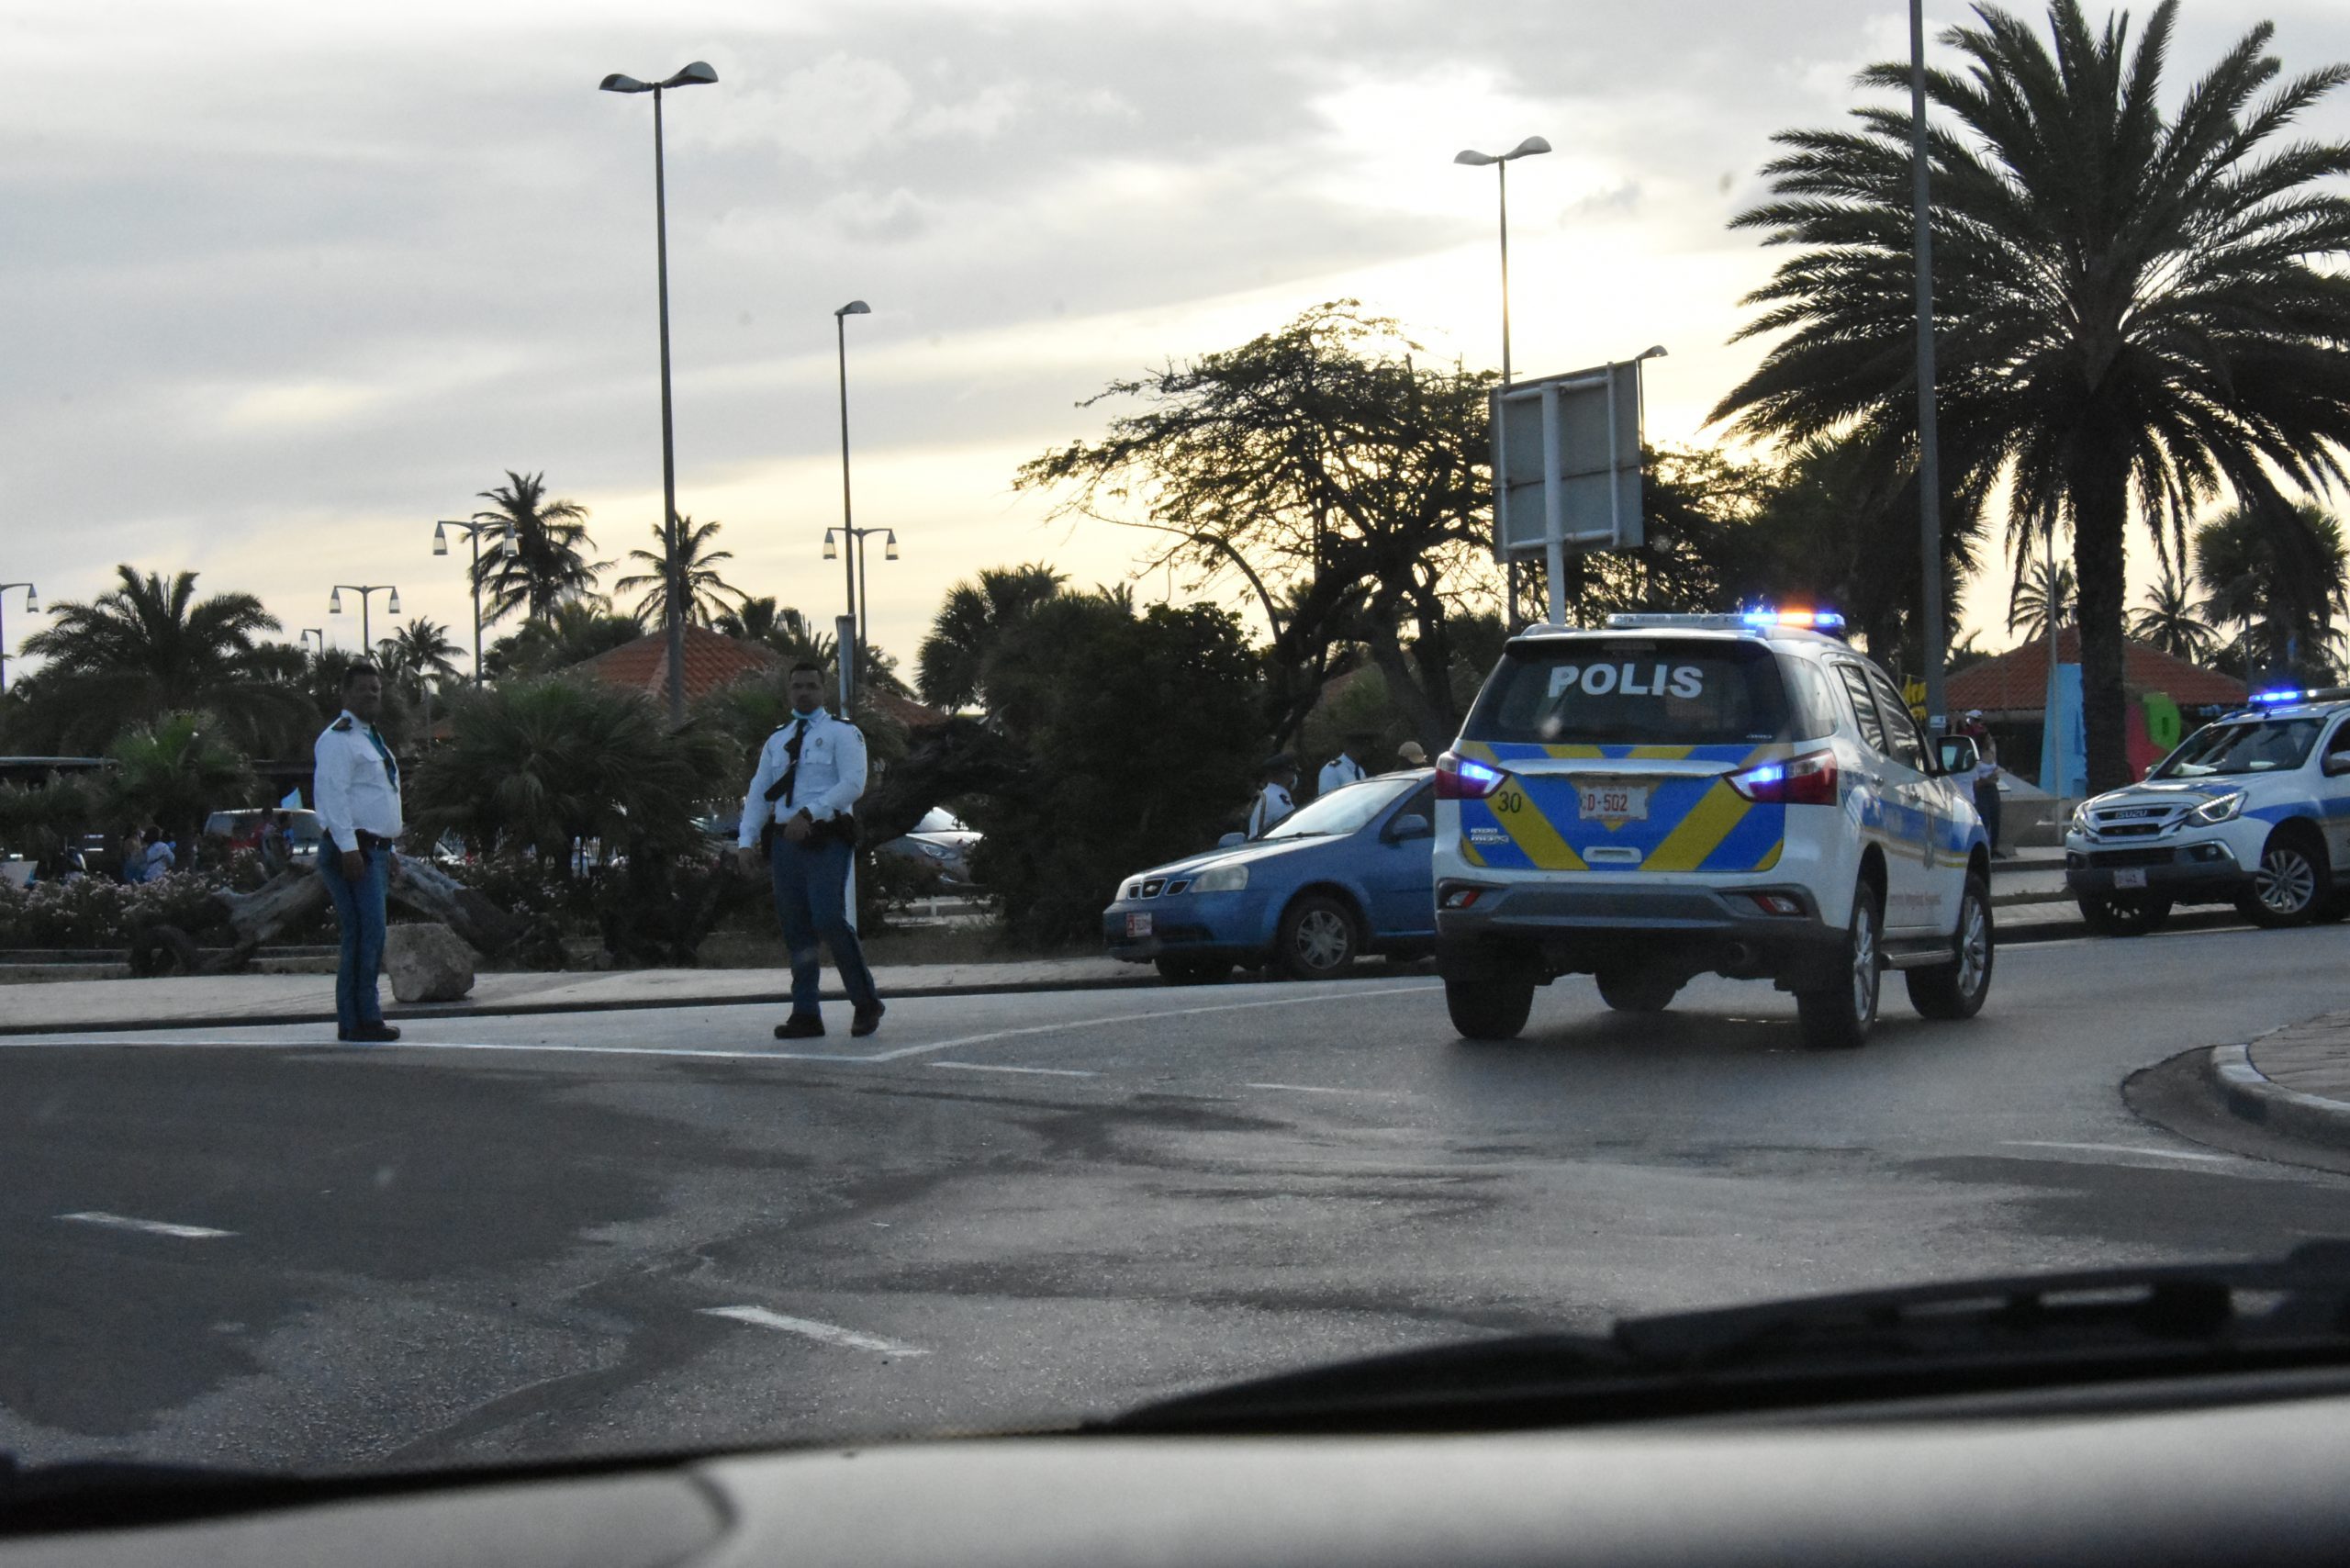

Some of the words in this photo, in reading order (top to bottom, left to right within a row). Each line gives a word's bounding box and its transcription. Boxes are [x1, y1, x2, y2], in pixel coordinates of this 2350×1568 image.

[1548, 663, 1704, 699] POLIS
[1497, 790, 1522, 814] 30
[1586, 793, 1628, 812] D-502
[2114, 809, 2148, 819] ISUZU
